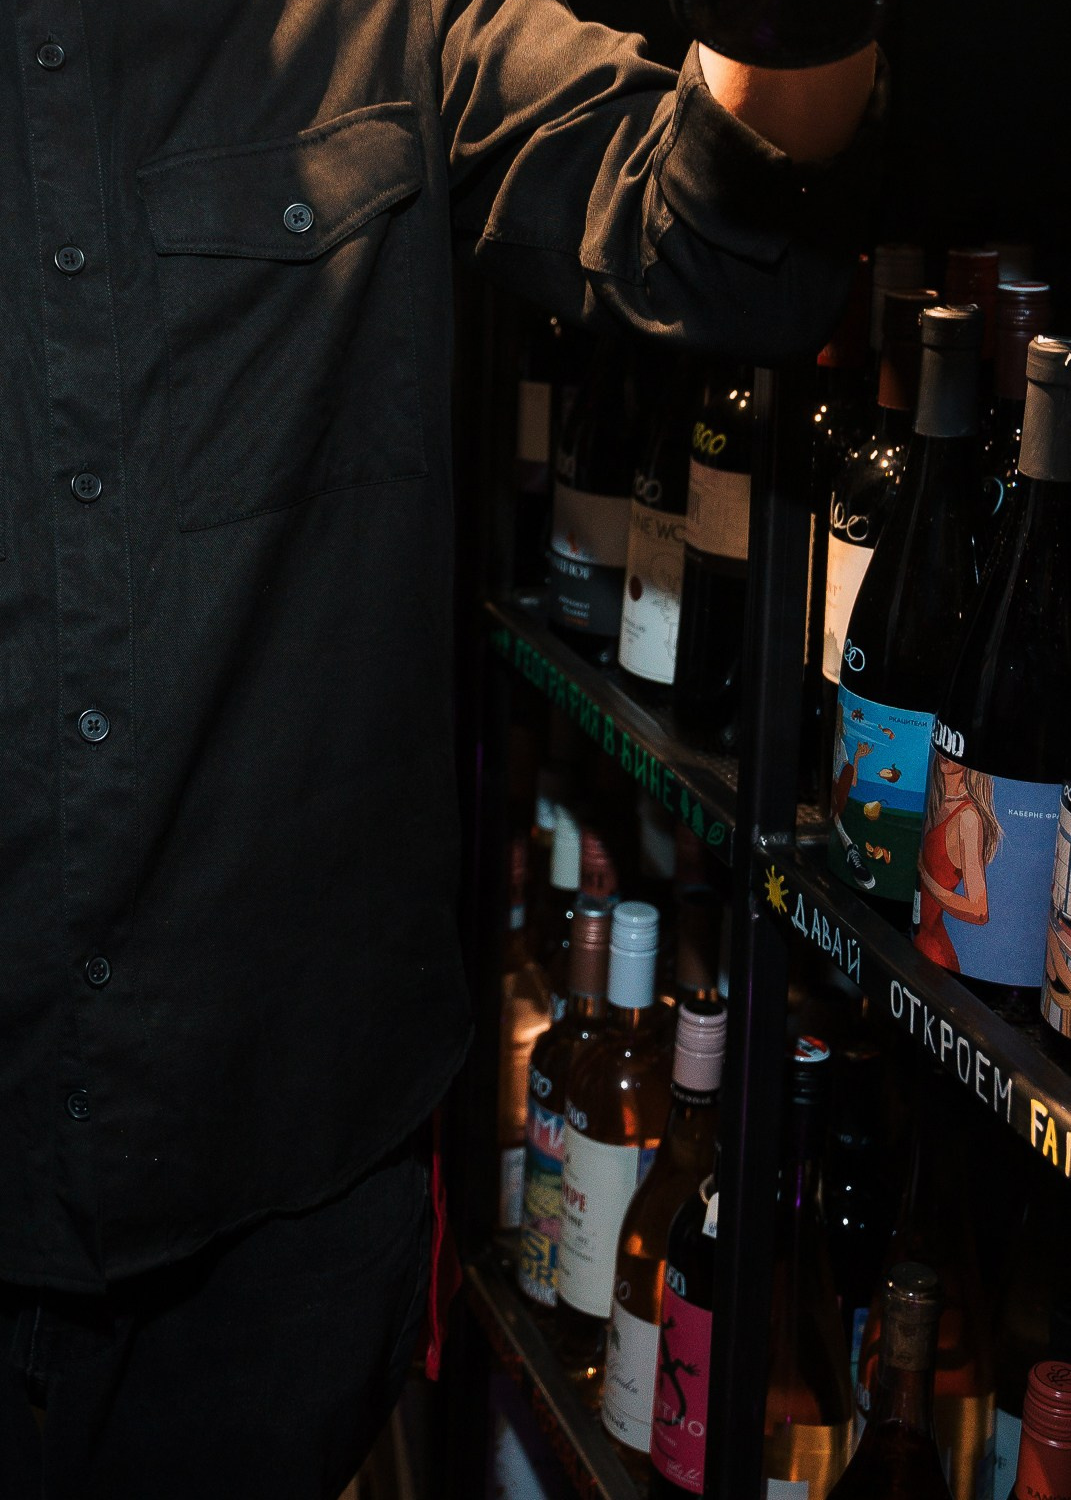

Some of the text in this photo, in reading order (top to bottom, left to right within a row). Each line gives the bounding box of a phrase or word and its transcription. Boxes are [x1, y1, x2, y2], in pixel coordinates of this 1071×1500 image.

[1008, 808, 1044, 819] КАБЕРНЕ
[791, 893, 863, 984] ДАВАЙ
[890, 980, 1012, 1123] ОТКРОЕМ
